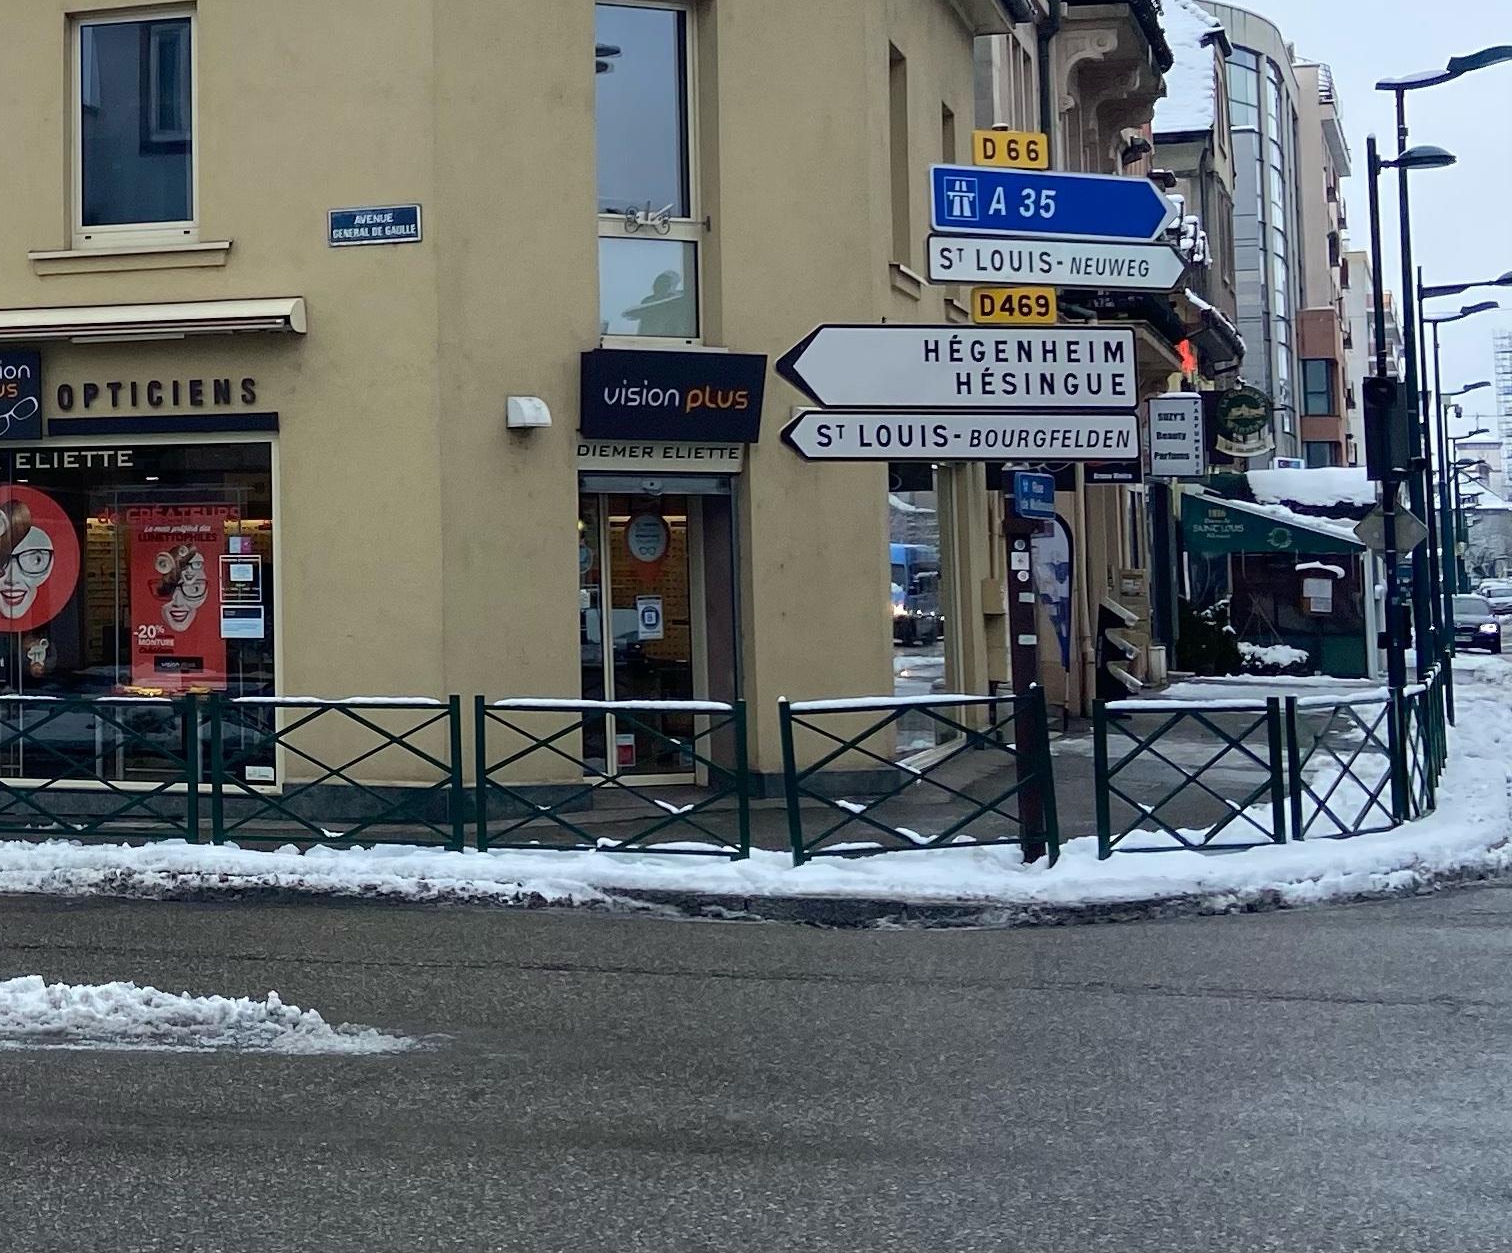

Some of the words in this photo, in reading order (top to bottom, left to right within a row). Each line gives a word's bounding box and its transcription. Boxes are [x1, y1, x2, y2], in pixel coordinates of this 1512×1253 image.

[982, 137, 996, 161] D
[1006, 138, 1039, 162] 66
[987, 186, 1007, 216] A
[1019, 187, 1057, 219] 35
[353, 212, 394, 225] AVENUE
[371, 225, 383, 237] DE
[384, 223, 416, 236] GAULLE
[979, 293, 1051, 318] D469
[923, 334, 1125, 364] HÉGENHEIM
[955, 366, 1126, 396] HÉSINGUE
[57, 377, 257, 411] OPTICIENS
[603, 379, 680, 407] vision
[685, 385, 749, 414] plus
[15, 450, 134, 470] ELIETTE
[576, 444, 654, 458] DIEMER
[662, 446, 739, 460] ELIETTE
